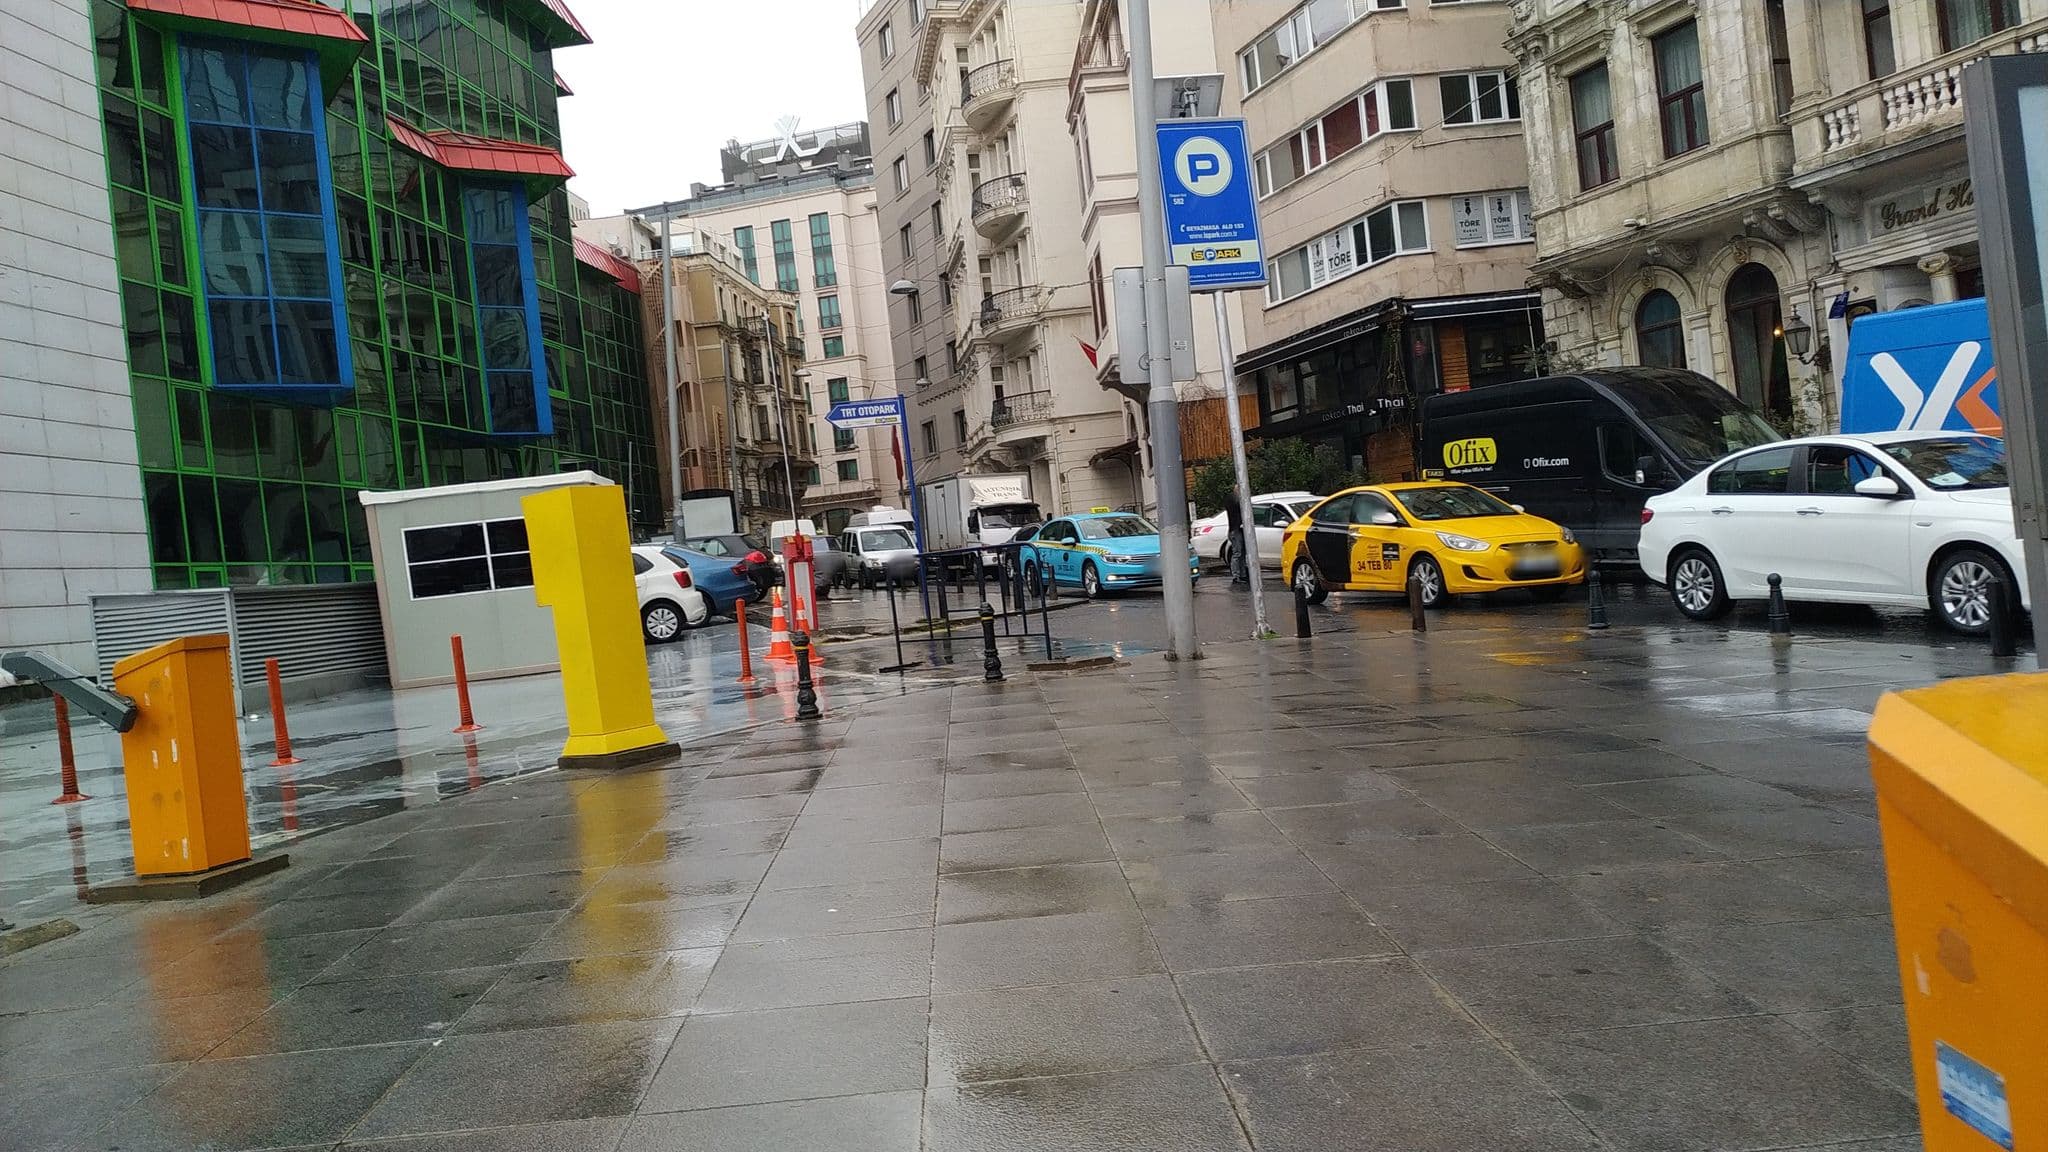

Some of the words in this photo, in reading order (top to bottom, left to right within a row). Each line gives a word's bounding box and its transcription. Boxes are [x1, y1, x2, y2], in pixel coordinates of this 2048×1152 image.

[1881, 188, 1941, 229] Grand
[1460, 219, 1480, 227] TÖRE
[1329, 251, 1351, 269] TÖRE
[1347, 402, 1364, 415] Thai
[1377, 396, 1404, 408] Thai
[841, 407, 857, 417] TRT
[858, 404, 896, 415] OTOPARK
[1449, 440, 1490, 465] Ofix
[1532, 457, 1570, 467] Ofix.com
[1357, 561, 1366, 571] 34
